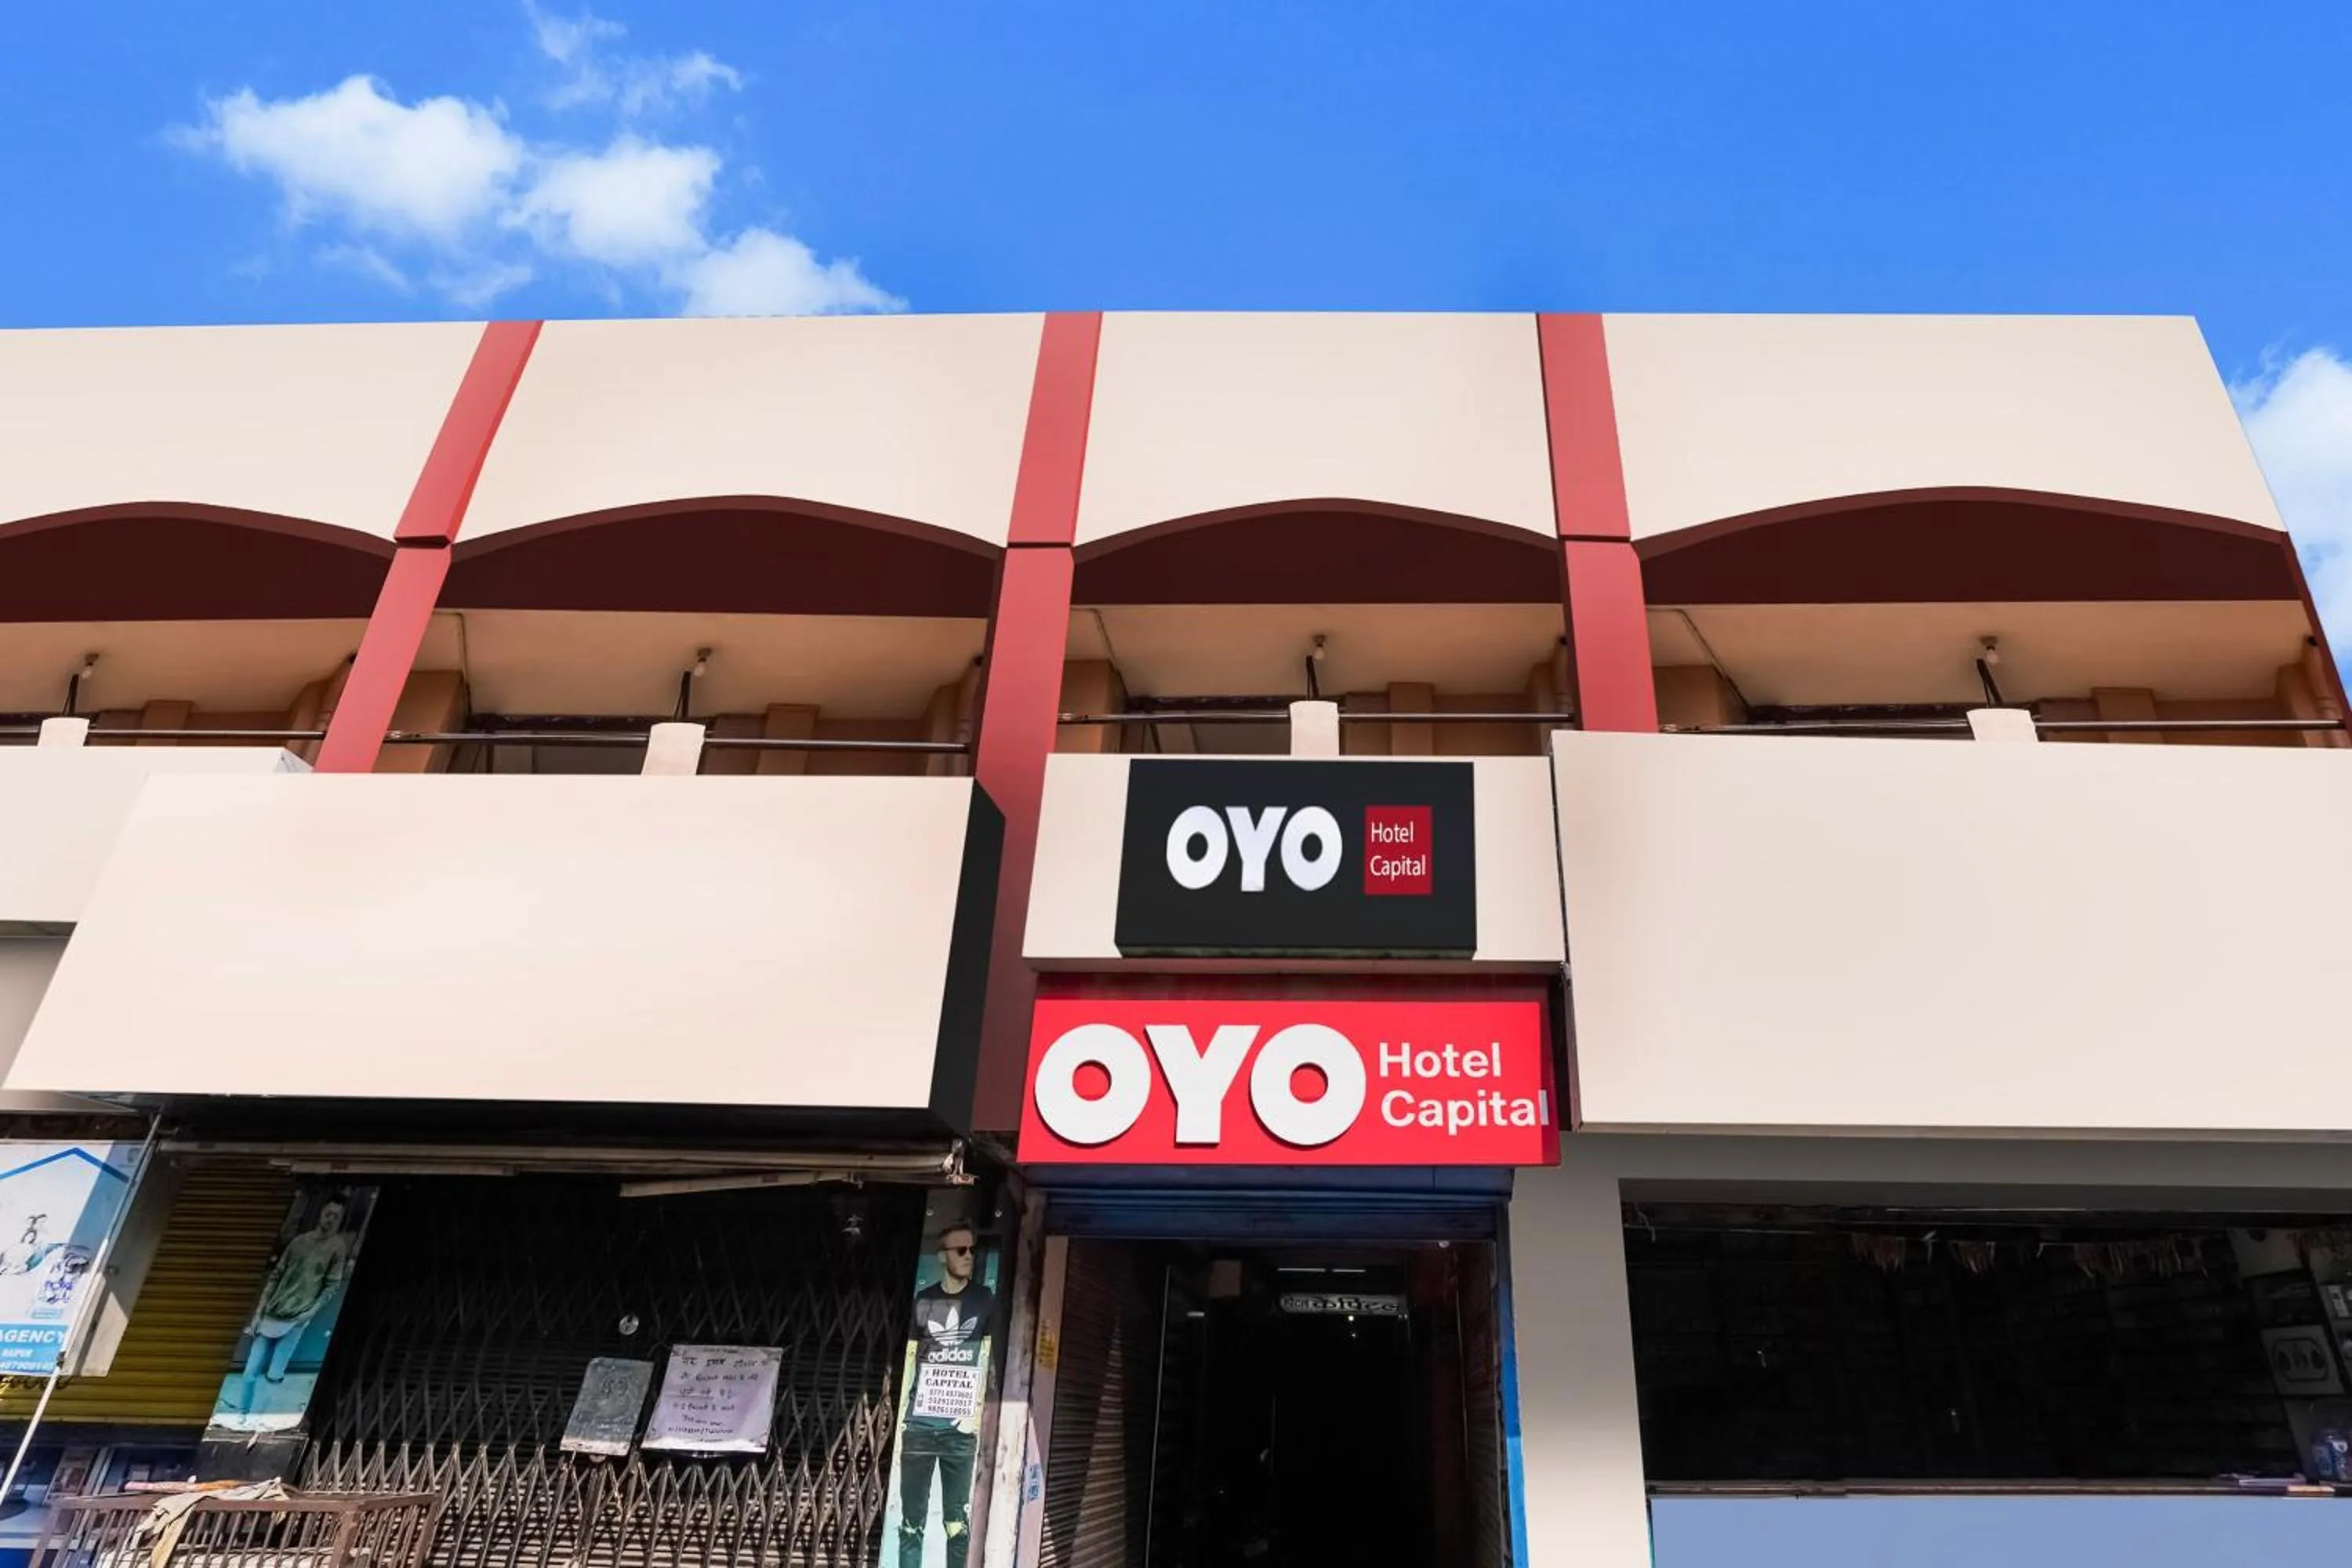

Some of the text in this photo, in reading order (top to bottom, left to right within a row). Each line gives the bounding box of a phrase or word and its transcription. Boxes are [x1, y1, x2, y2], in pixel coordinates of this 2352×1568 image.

[1370, 821, 1414, 844] Hotel
[1166, 805, 1342, 891] OYO
[1370, 855, 1427, 880] Capital
[1378, 1043, 1501, 1078] Hotel
[1035, 1024, 1367, 1145] OYO
[1381, 1089, 1549, 1136] Capital
[0, 1329, 64, 1344] GENCY
[927, 1348, 974, 1363] adidas
[925, 1377, 973, 1388] CAPITAL
[931, 1368, 970, 1379] HOTEL
